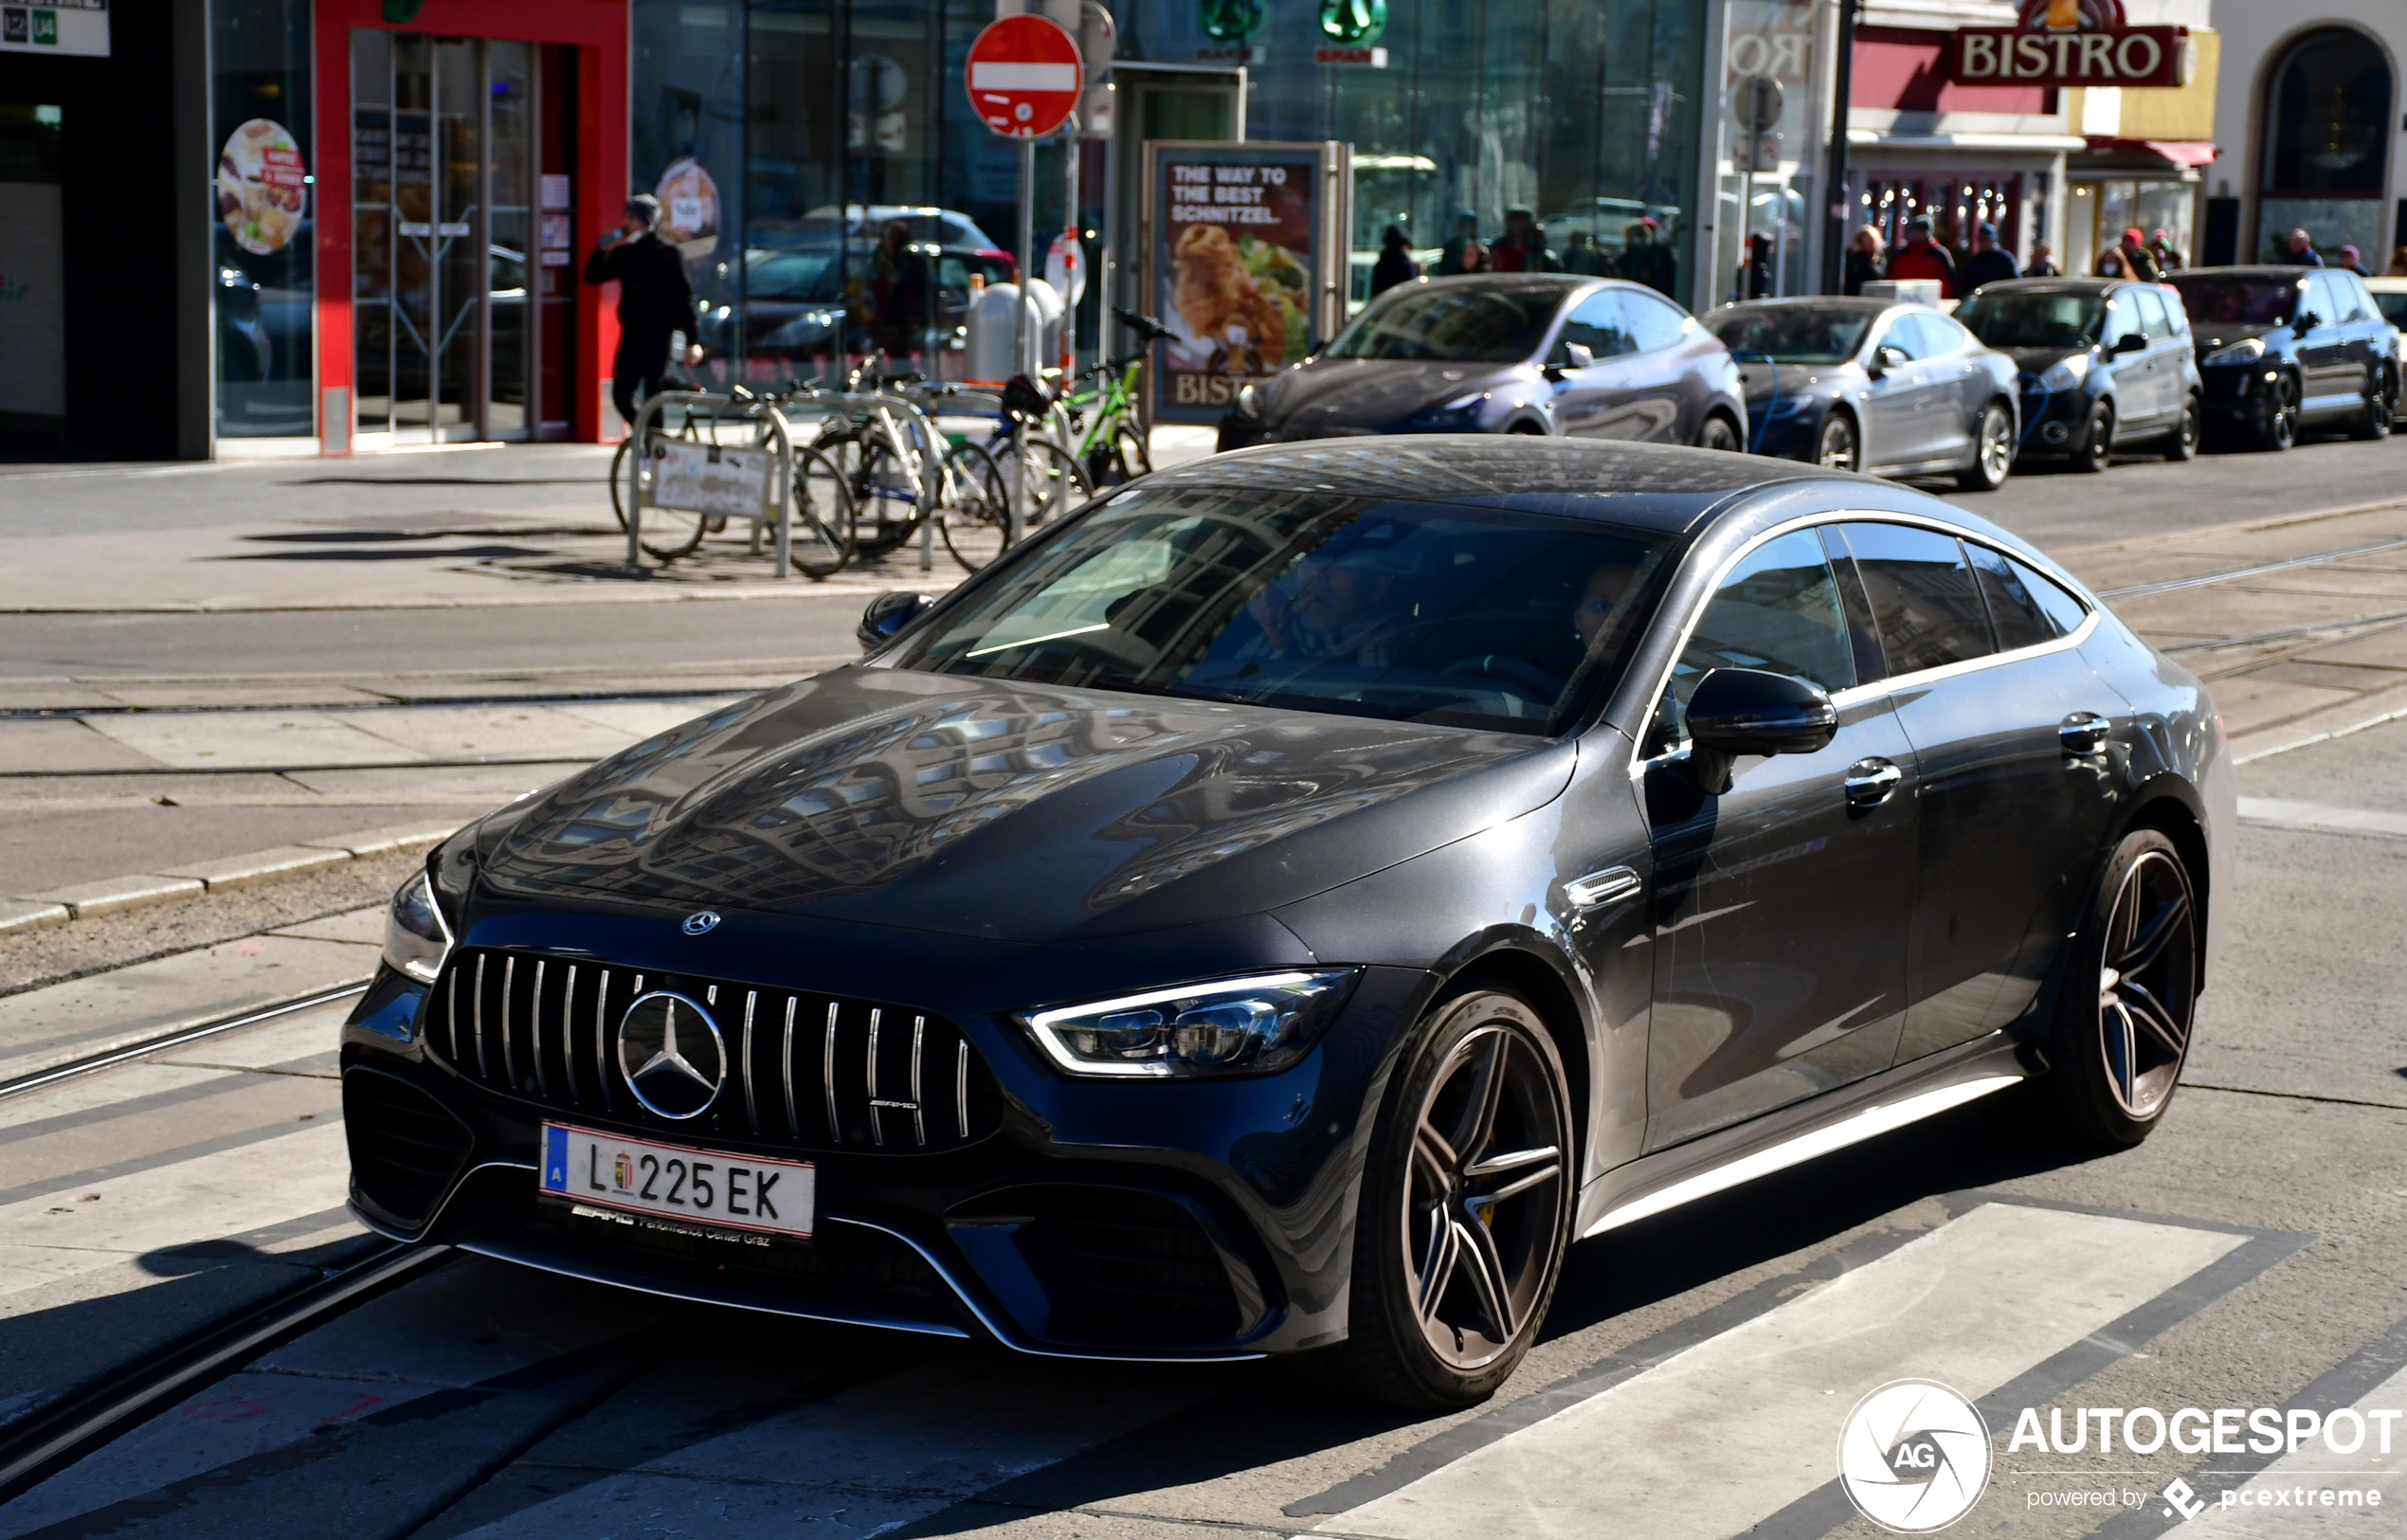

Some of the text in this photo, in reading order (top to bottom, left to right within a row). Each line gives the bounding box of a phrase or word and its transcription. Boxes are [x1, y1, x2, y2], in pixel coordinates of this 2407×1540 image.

[32, 17, 55, 38] U4
[1962, 33, 2162, 79] BISTRO
[1172, 166, 1287, 186] THE WAY TO
[1171, 185, 1264, 204] THE BEST
[1176, 373, 1248, 405] BIST
[551, 1167, 562, 1183] A
[590, 1144, 780, 1220] L 225 EK
[590, 1208, 770, 1247] AMG Performance Center Graz
